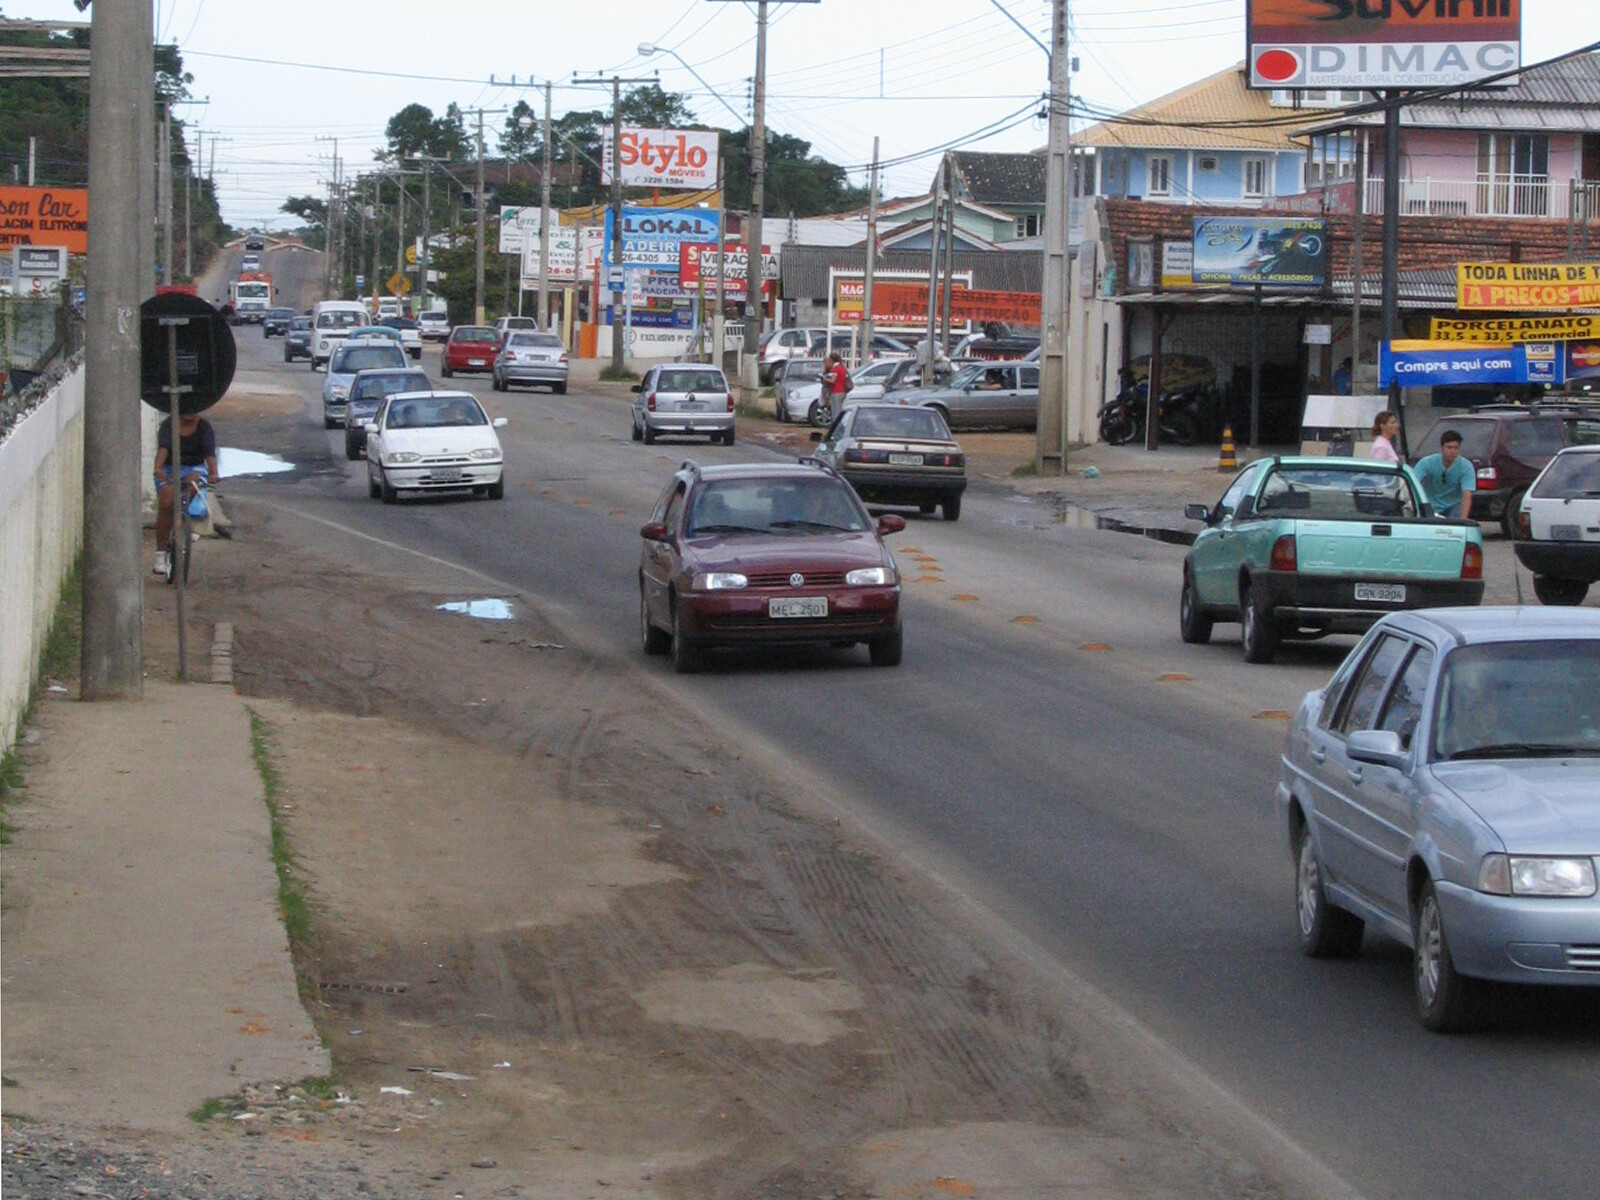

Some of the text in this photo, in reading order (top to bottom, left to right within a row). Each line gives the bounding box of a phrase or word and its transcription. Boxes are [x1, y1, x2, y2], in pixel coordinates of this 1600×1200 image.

[1311, 44, 1514, 72] DIMAC
[1364, 75, 1392, 83] PARA
[619, 133, 707, 174] Stylo
[38, 193, 80, 217] Car
[623, 218, 709, 234] LOKAL
[1464, 265, 1507, 280] TODA
[1513, 266, 1560, 281] LINHA
[1567, 266, 1586, 280] DE
[1468, 287, 1484, 305] A
[1490, 286, 1571, 308] PREÇOS
[1437, 317, 1592, 331] PORCELANATO
[1435, 331, 1464, 341] 33,5
[1484, 331, 1513, 341] 33,5
[1520, 329, 1590, 340] Comercial
[1394, 359, 1512, 374] Compre aqui com
[800, 604, 826, 616] 2501
